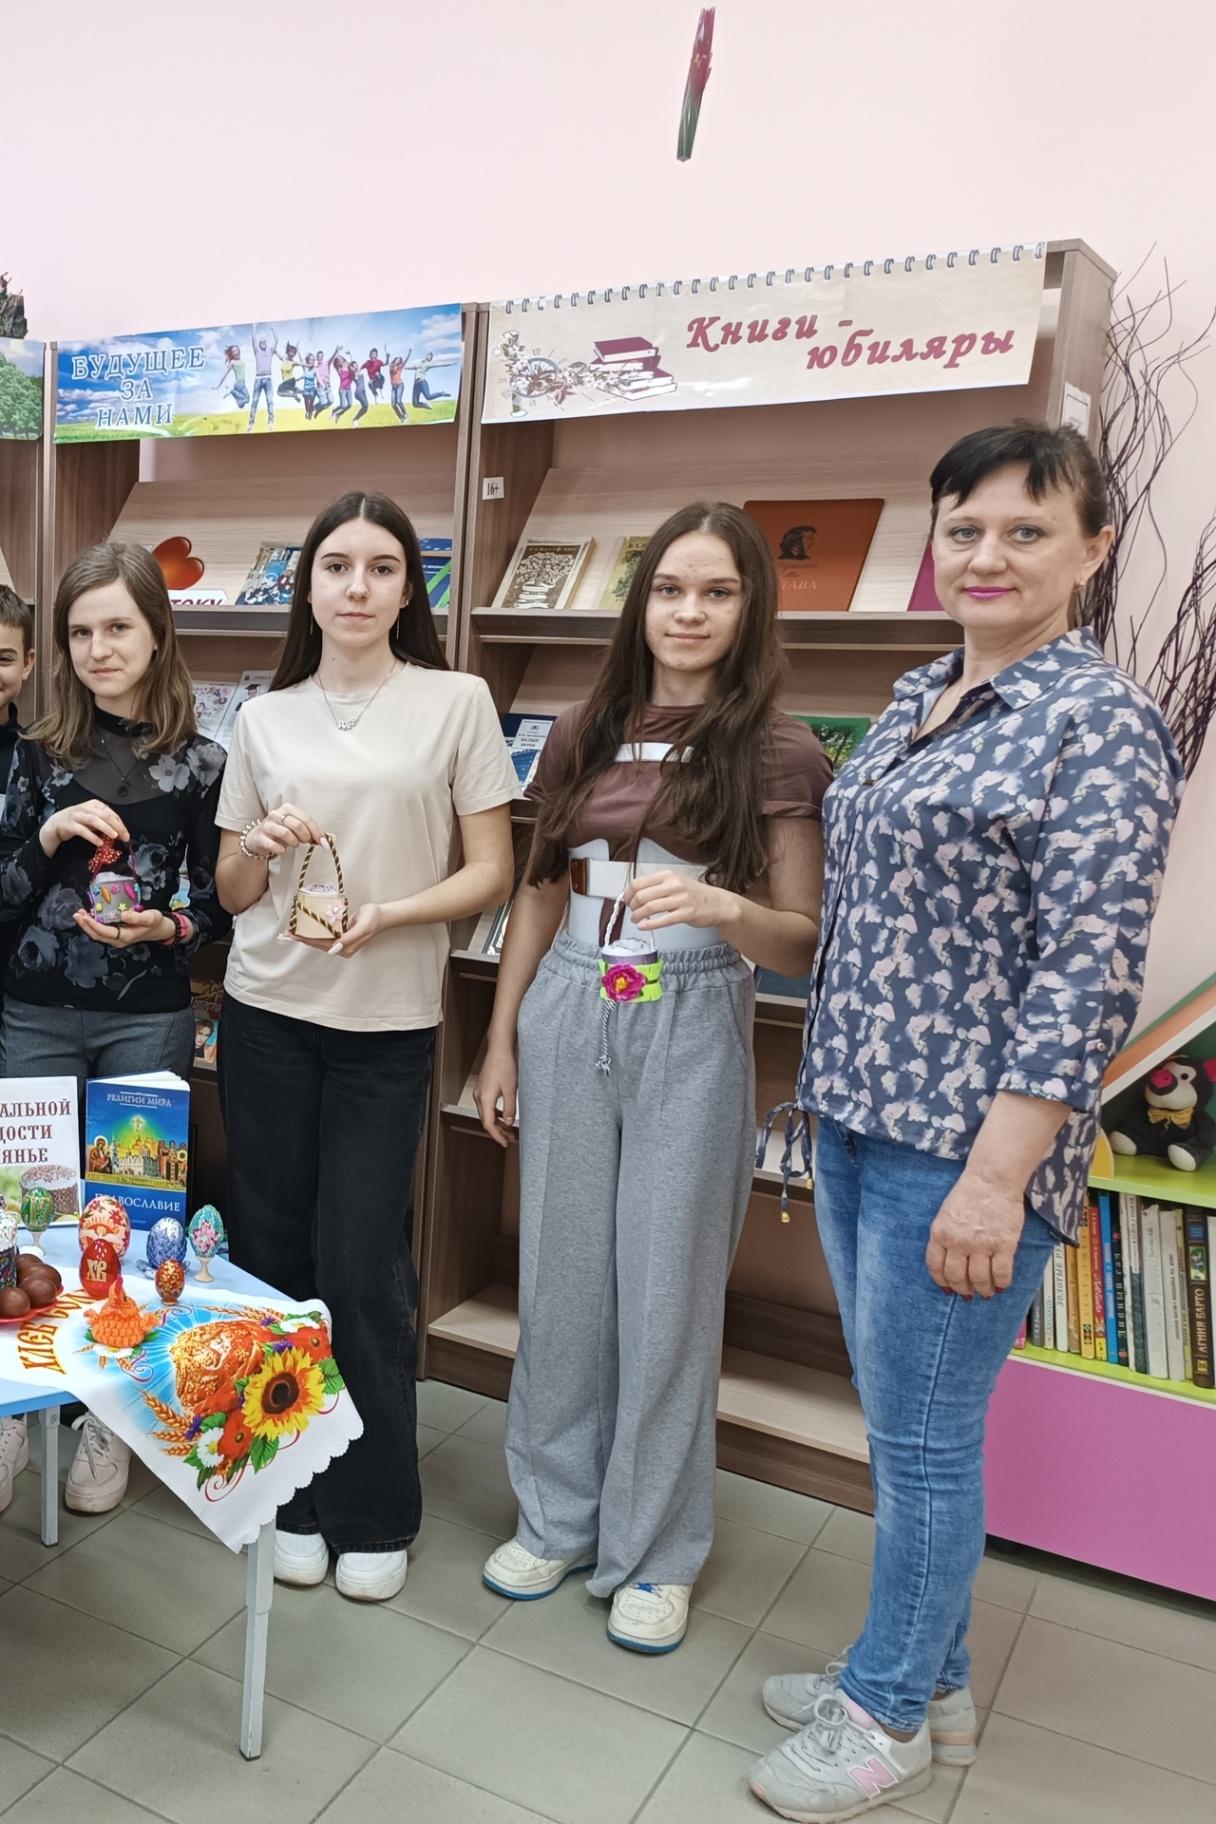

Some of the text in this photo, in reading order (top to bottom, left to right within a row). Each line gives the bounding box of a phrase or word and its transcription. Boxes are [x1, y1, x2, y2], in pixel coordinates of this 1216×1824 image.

[686, 314, 818, 353] Книги
[806, 328, 1015, 370] юбиляры
[71, 346, 207, 380] БУДУЩЕЕ
[119, 378, 153, 401] ЗА
[97, 403, 174, 429] НАМИ
[487, 482, 500, 496] 16+
[147, 1097, 172, 1108] МИРА
[95, 1192, 181, 1212] ПВОСЛАВИЕ
[1194, 1288, 1208, 1353] АГНИЯ БАРТО
